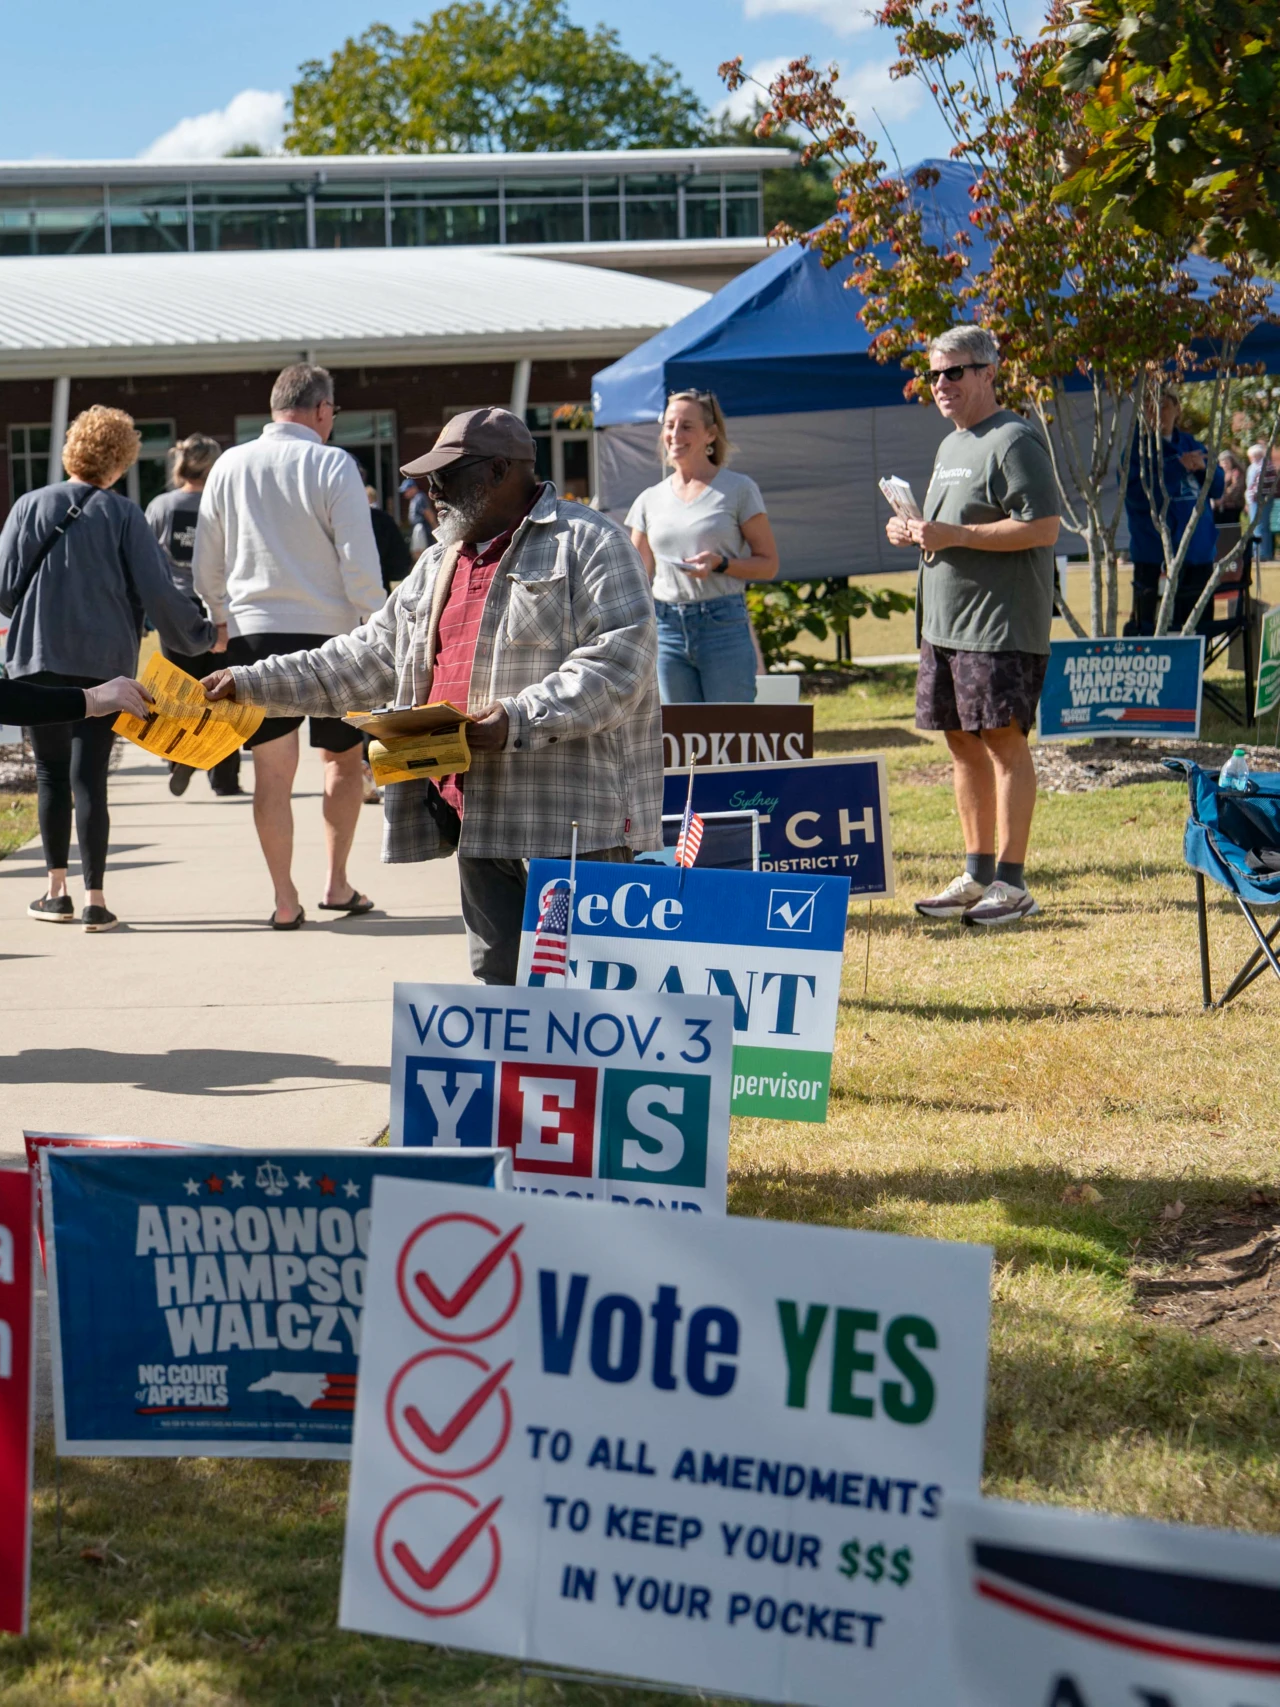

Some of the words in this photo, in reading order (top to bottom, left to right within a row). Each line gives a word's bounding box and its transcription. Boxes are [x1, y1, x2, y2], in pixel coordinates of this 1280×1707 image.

[1064, 655, 1171, 676] ARROWOOD
[1069, 671, 1164, 691] HAMPSON
[1071, 687, 1160, 707] WALCZYK
[662, 732, 804, 767] OPKINS
[729, 791, 779, 813] Sydney
[762, 857, 838, 872] DISTRICT
[844, 855, 859, 866] 17
[409, 1003, 530, 1052] VOTE
[546, 1010, 665, 1061] NOV.
[680, 1018, 713, 1064] 3
[732, 1071, 822, 1100] pervisor
[416, 1069, 685, 1173] YES
[136, 1205, 372, 1256] ARROWO
[154, 1255, 368, 1308] HAMPSO
[164, 1303, 363, 1358] WALCZY
[538, 1268, 741, 1398] Vote
[775, 1298, 939, 1426] YES
[138, 1365, 166, 1385] NC
[167, 1365, 228, 1385] COURT
[148, 1386, 229, 1406] APPEALS
[526, 1426, 572, 1462] TO
[587, 1437, 655, 1476] ALL
[671, 1450, 943, 1519] AMENDMENTS
[545, 1496, 589, 1532] TO
[606, 1508, 702, 1549] KEEP
[721, 1523, 820, 1569] YOUR
[838, 1538, 912, 1587] $$$
[561, 1564, 596, 1601] IN
[613, 1574, 710, 1618] YOUR
[729, 1589, 883, 1649] POCKET
